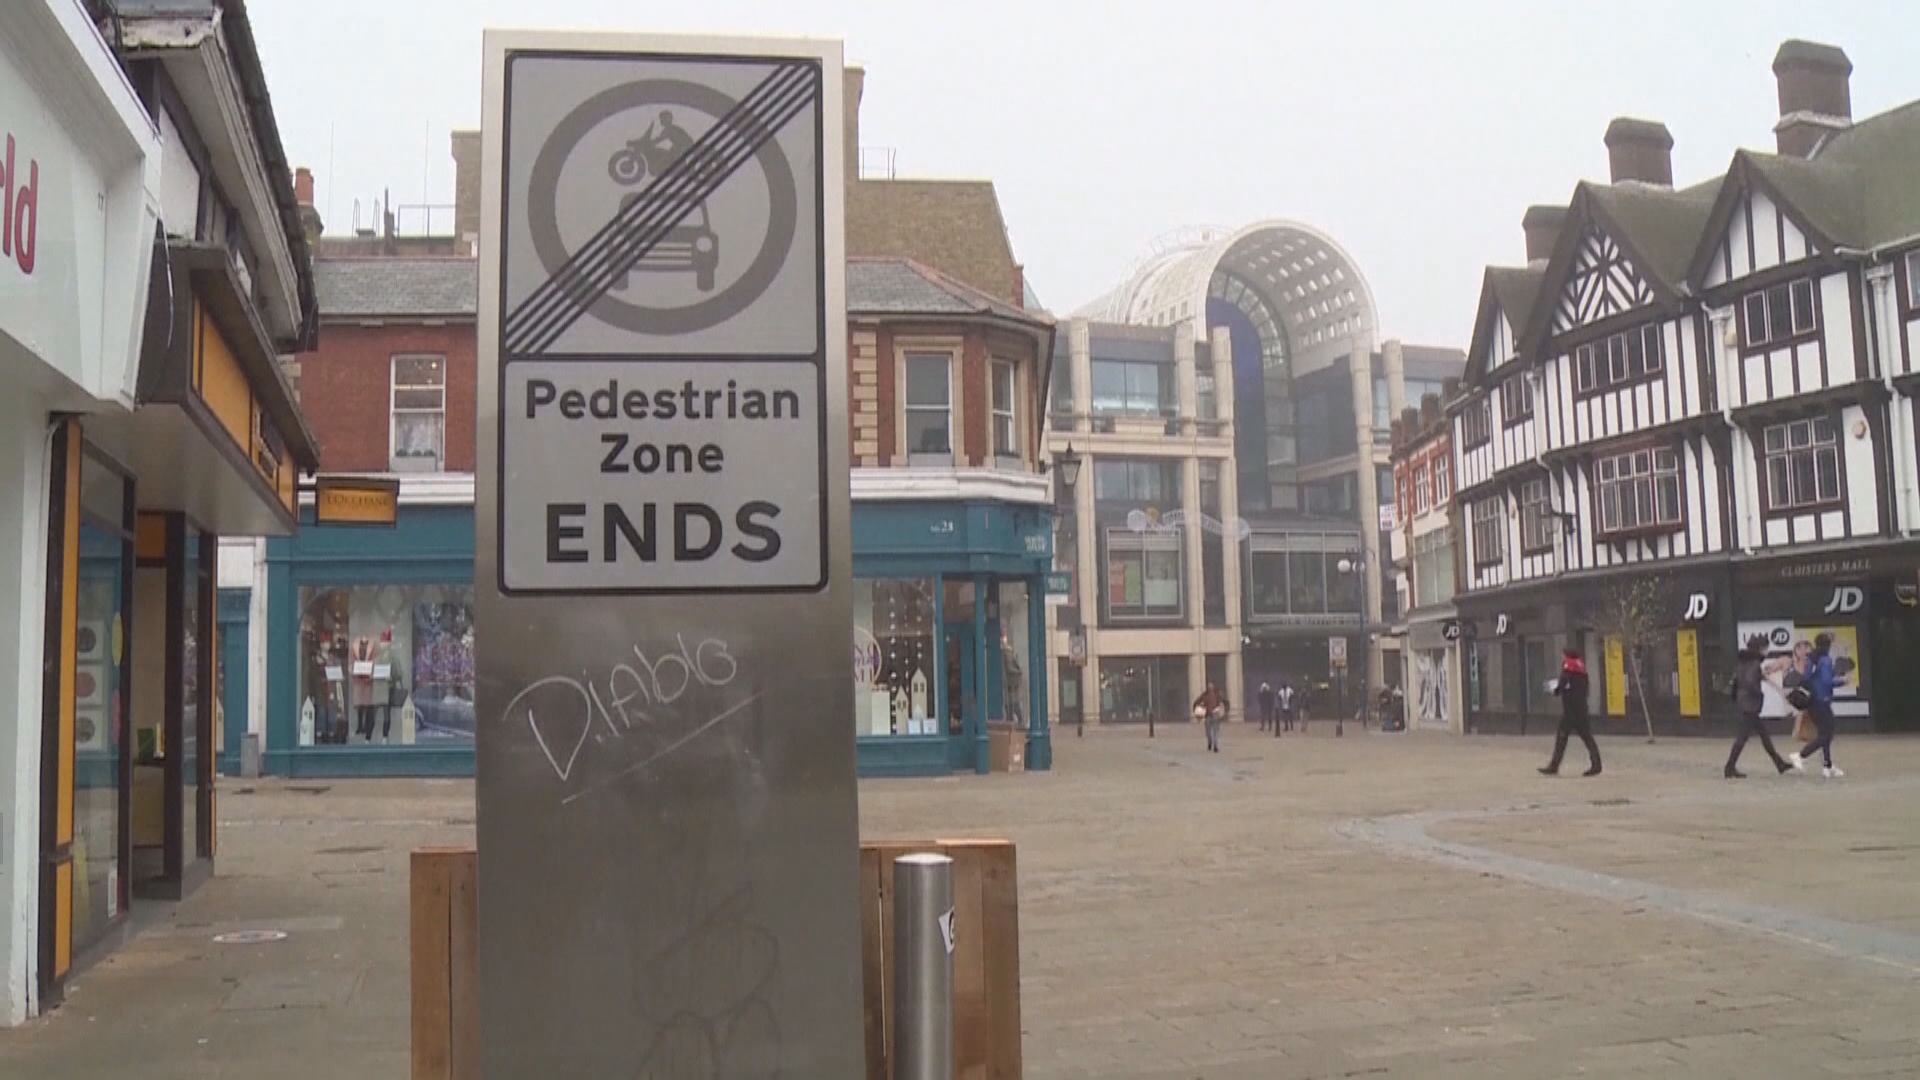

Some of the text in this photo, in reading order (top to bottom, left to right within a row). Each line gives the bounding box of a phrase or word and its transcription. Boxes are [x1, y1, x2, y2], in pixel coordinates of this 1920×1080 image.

[526, 379, 799, 420] Pedestrian
[600, 433, 724, 473] Zone
[546, 501, 782, 563] ENDS
[1842, 558, 1872, 571] MALL
[1684, 594, 1708, 620] JD
[1824, 586, 1864, 614] JD
[1445, 625, 1460, 638] JD
[1496, 614, 1507, 636] JD
[1774, 631, 1788, 644] JD
